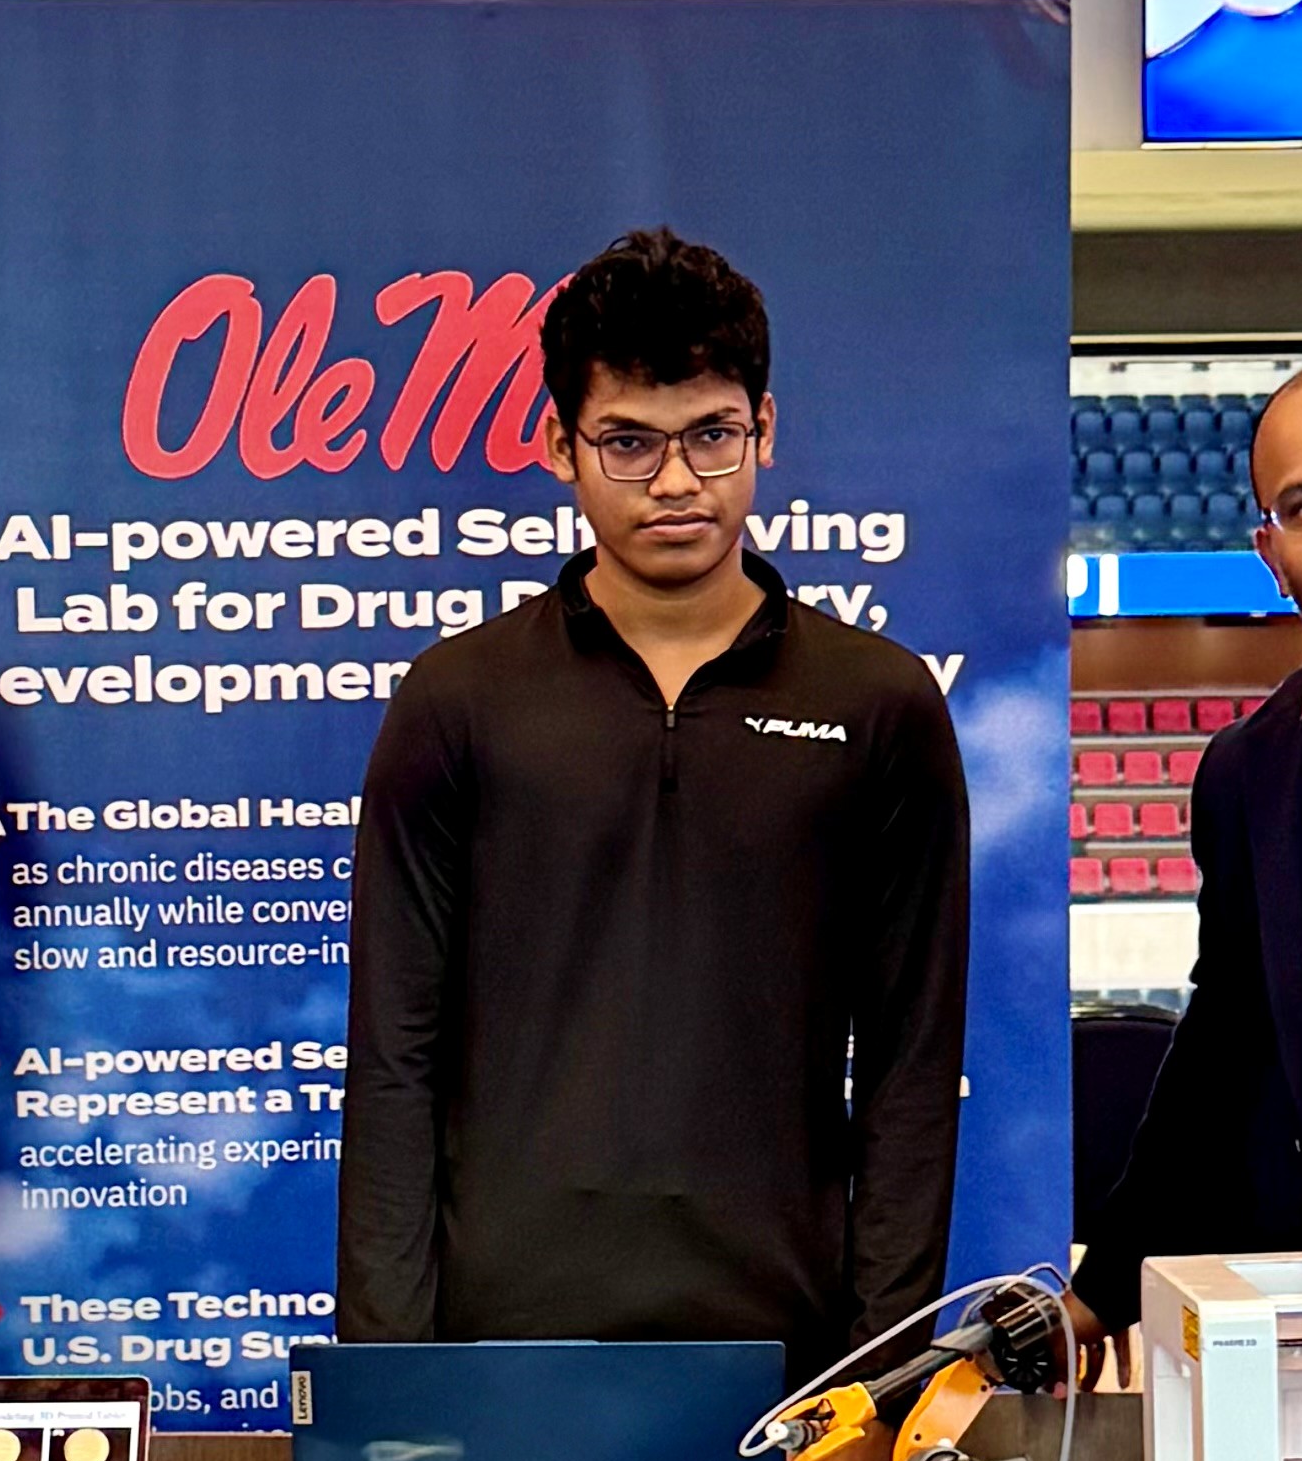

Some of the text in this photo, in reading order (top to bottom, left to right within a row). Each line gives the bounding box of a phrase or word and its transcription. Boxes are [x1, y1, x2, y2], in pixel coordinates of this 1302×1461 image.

[122, 273, 375, 479] Ole
[745, 499, 905, 562] ving
[17, 584, 158, 633] Lab
[173, 581, 286, 631] for
[301, 583, 483, 637] Drug
[763, 719, 847, 742] PUMA
[7, 796, 362, 830] The Global Heal
[12, 862, 48, 884] as
[57, 853, 176, 884] chronic
[184, 852, 324, 883] diseases
[13, 895, 352, 931] annually while conve
[14, 935, 350, 970] slow and resource-in
[13, 1040, 348, 1081] AI-powered Se
[16, 1083, 345, 1124] Represent a Tr
[19, 1136, 217, 1169] accelerating
[21, 1178, 187, 1210] innovation
[20, 1289, 336, 1323] These Techno
[22, 1335, 112, 1366] U.S.
[122, 1335, 231, 1367] Drug
[150, 1380, 279, 1414] obs, and
